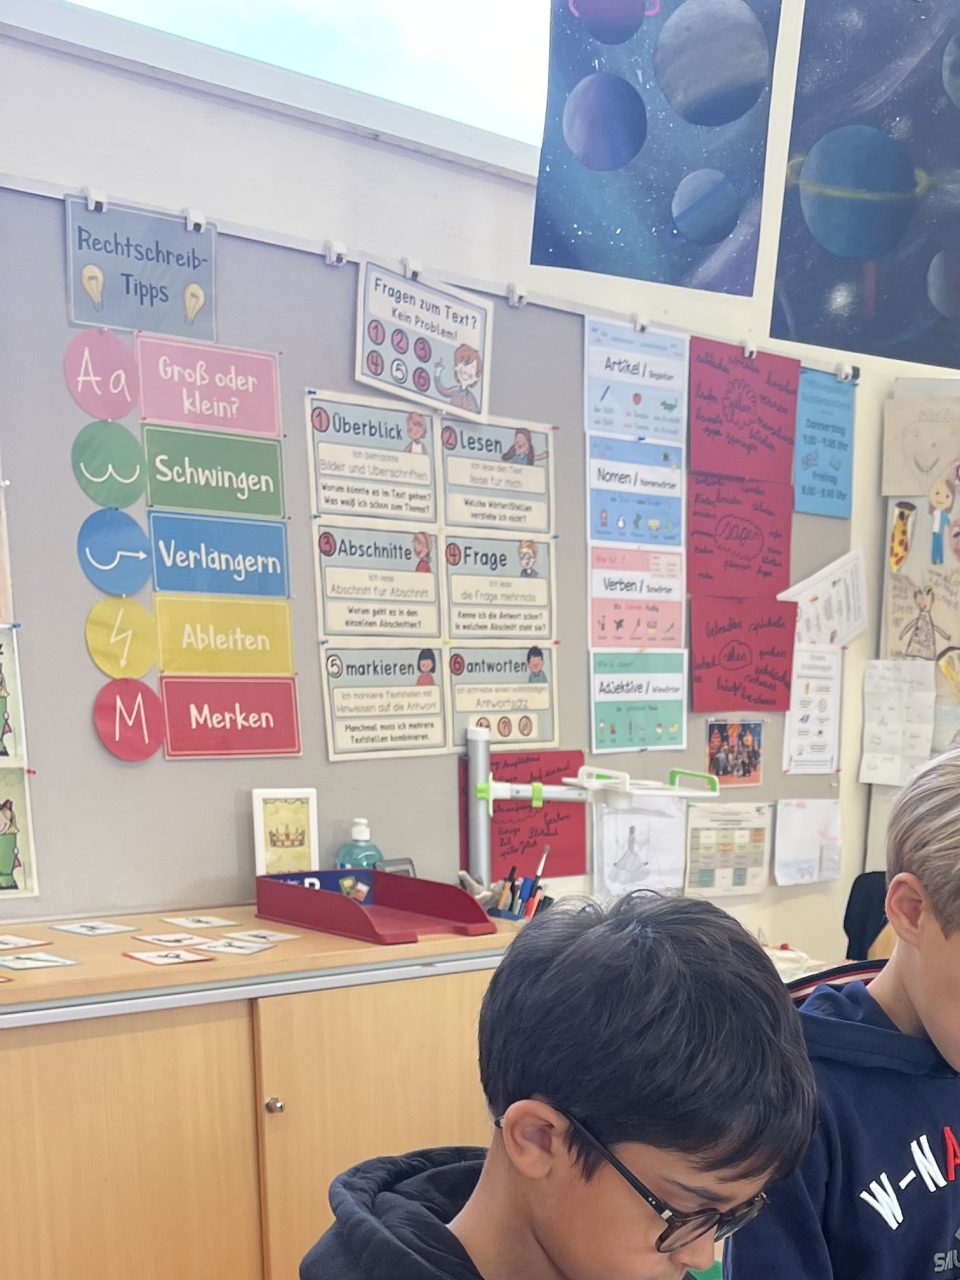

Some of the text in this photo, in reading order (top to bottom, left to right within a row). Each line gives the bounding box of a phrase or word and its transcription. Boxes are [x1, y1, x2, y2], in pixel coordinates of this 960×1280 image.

[77, 225, 208, 270] Rechtschreib-
[120, 272, 169, 307] Tipps
[374, 277, 416, 306] Fragen
[419, 299, 441, 316] zum
[391, 307, 458, 341] Kein Problem!
[158, 355, 257, 392] Groß oder
[605, 357, 640, 376] Artikel
[182, 387, 240, 418] klein?
[332, 412, 403, 441] Überblick
[155, 454, 274, 499] Schwingen
[597, 467, 631, 485] Nomen
[158, 539, 281, 581] Verlängern
[338, 539, 412, 561] Abschnitte
[463, 546, 508, 569] Frage
[603, 577, 637, 592] Verben
[182, 623, 270, 651] Ableiten
[345, 660, 415, 677] markieren
[466, 657, 528, 674] antworten
[599, 681, 644, 695] Adjektive
[115, 692, 149, 744] M
[190, 702, 274, 730] Merken
